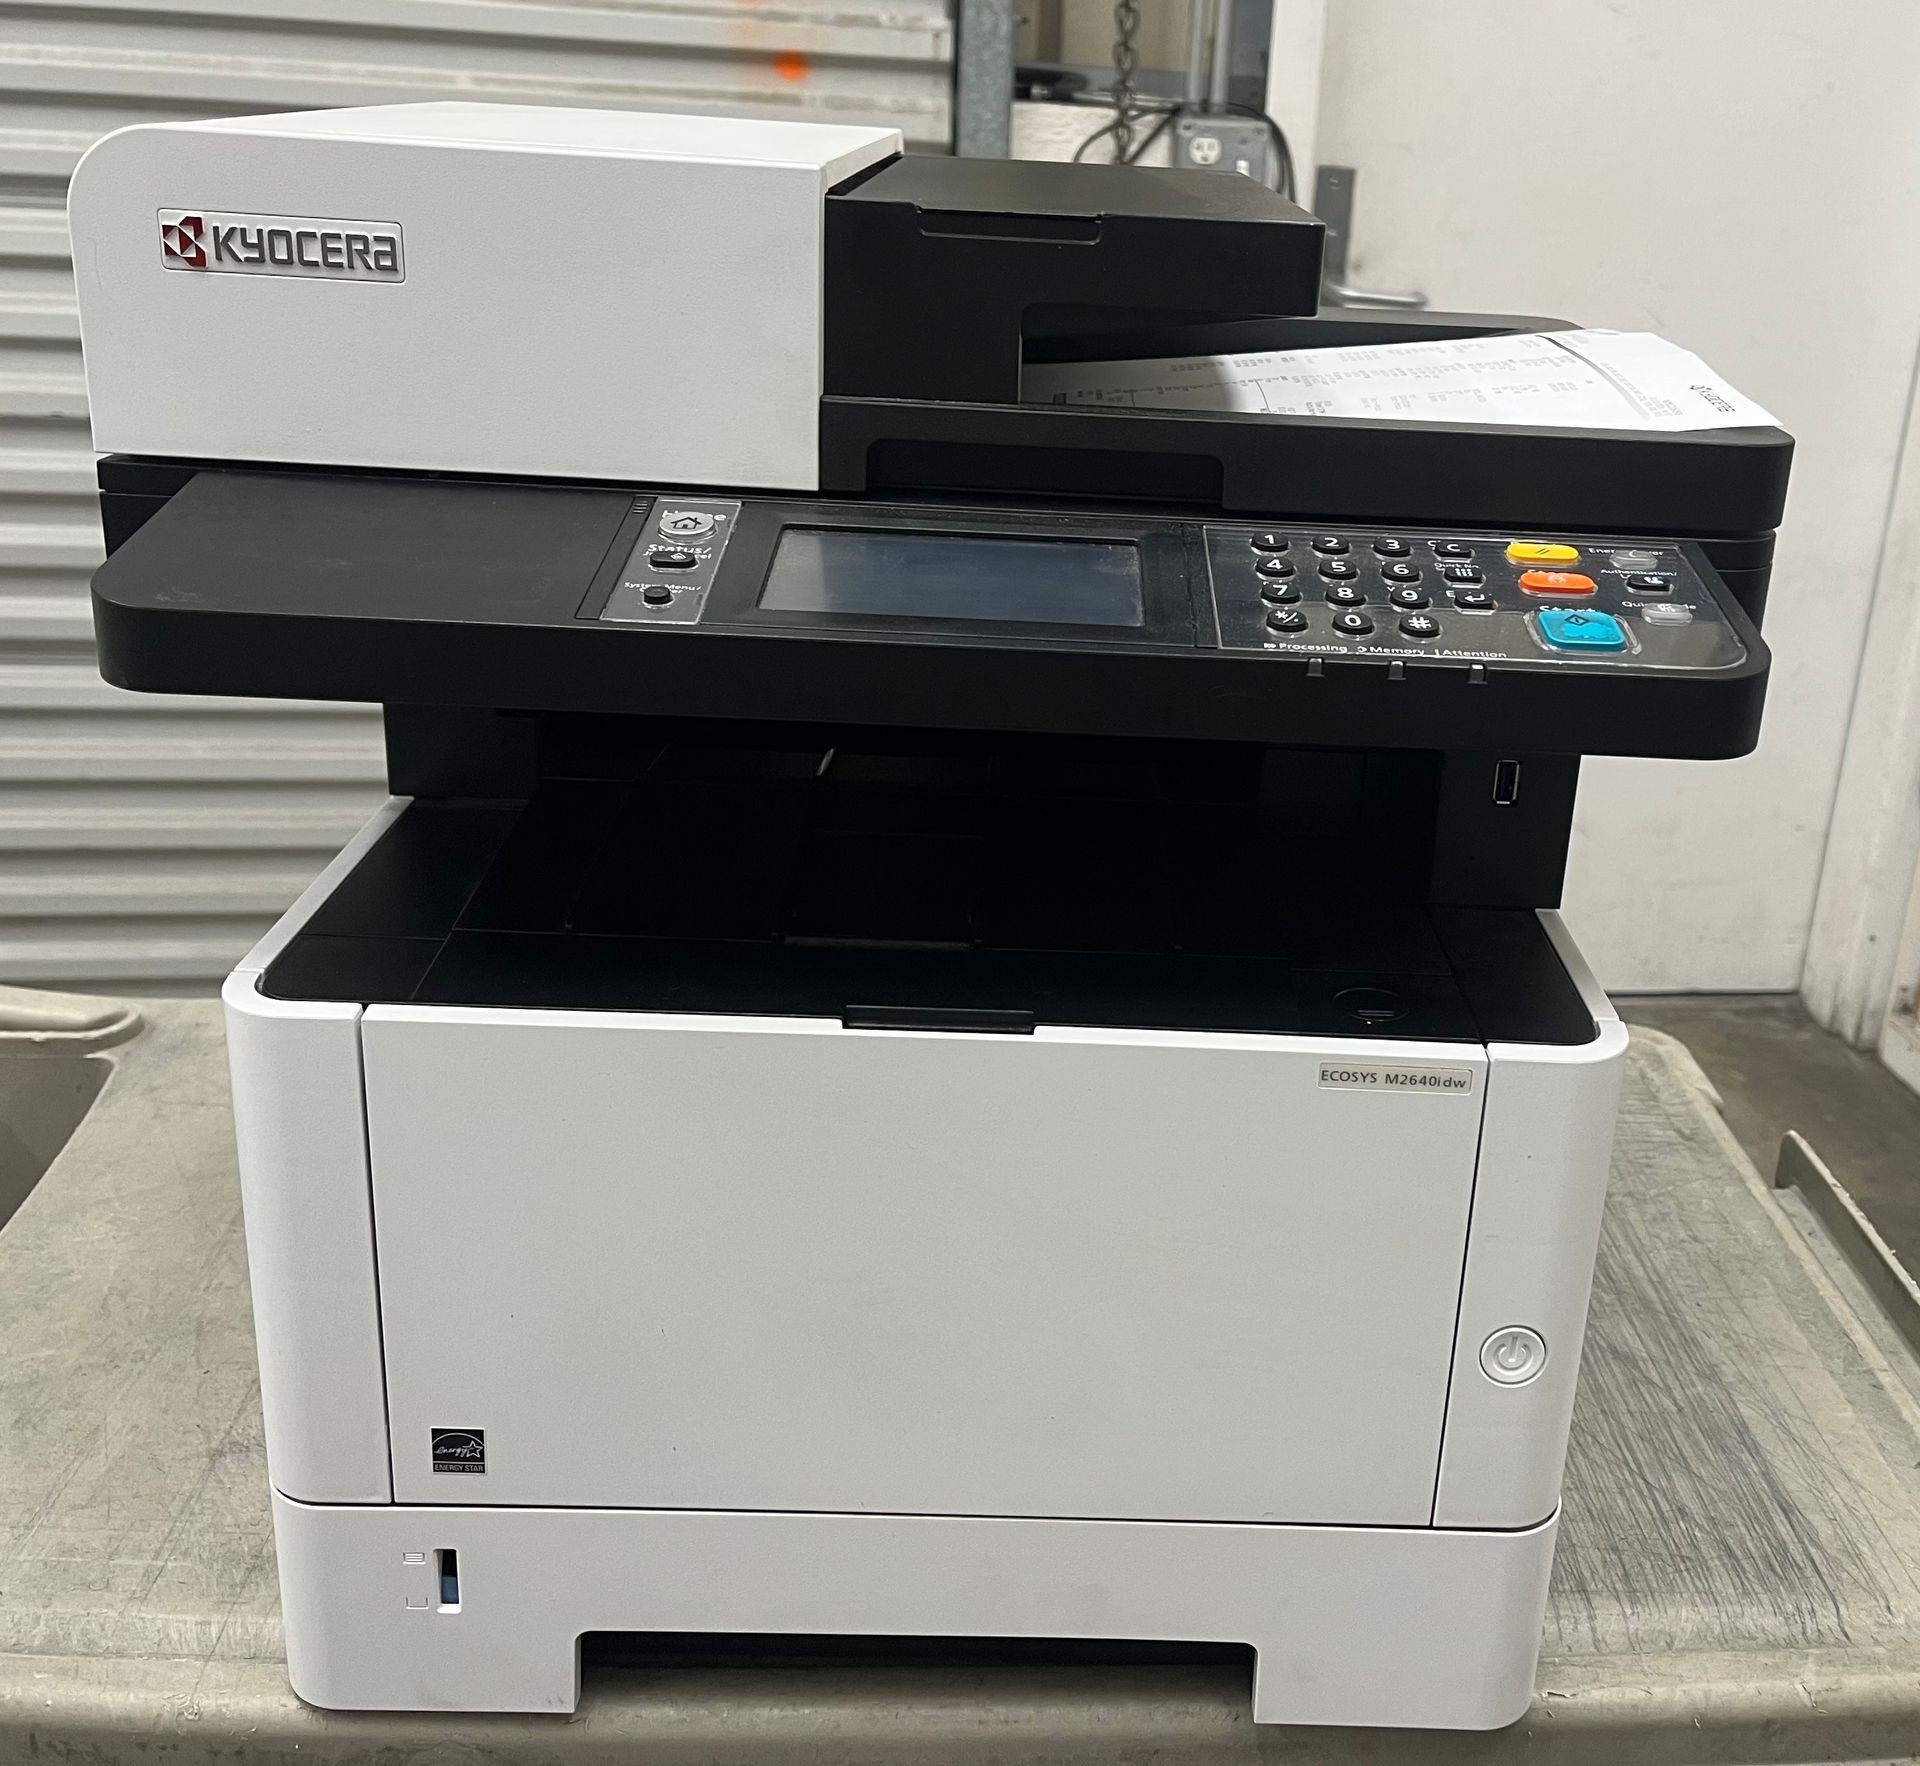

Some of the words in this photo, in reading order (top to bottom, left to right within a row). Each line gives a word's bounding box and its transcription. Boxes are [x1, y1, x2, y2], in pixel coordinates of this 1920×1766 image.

[1264, 534, 1275, 545] 1
[1324, 537, 1340, 547] 2
[1385, 539, 1401, 550] 3
[1446, 543, 1461, 552] C
[1266, 559, 1283, 570] 4
[1331, 561, 1347, 572] 5
[1393, 563, 1410, 575] 6
[1272, 584, 1288, 596] 7
[1337, 587, 1355, 599] 8
[1401, 589, 1418, 601] 9
[1344, 614, 1362, 627] 0
[1408, 613, 1433, 630] #
[1279, 642, 1349, 654] Processing
[1369, 646, 1425, 656] Memory
[1443, 649, 1508, 659] Attention
[1321, 1069, 1378, 1084] ECOSYS
[1384, 1073, 1467, 1089] M2640idw
